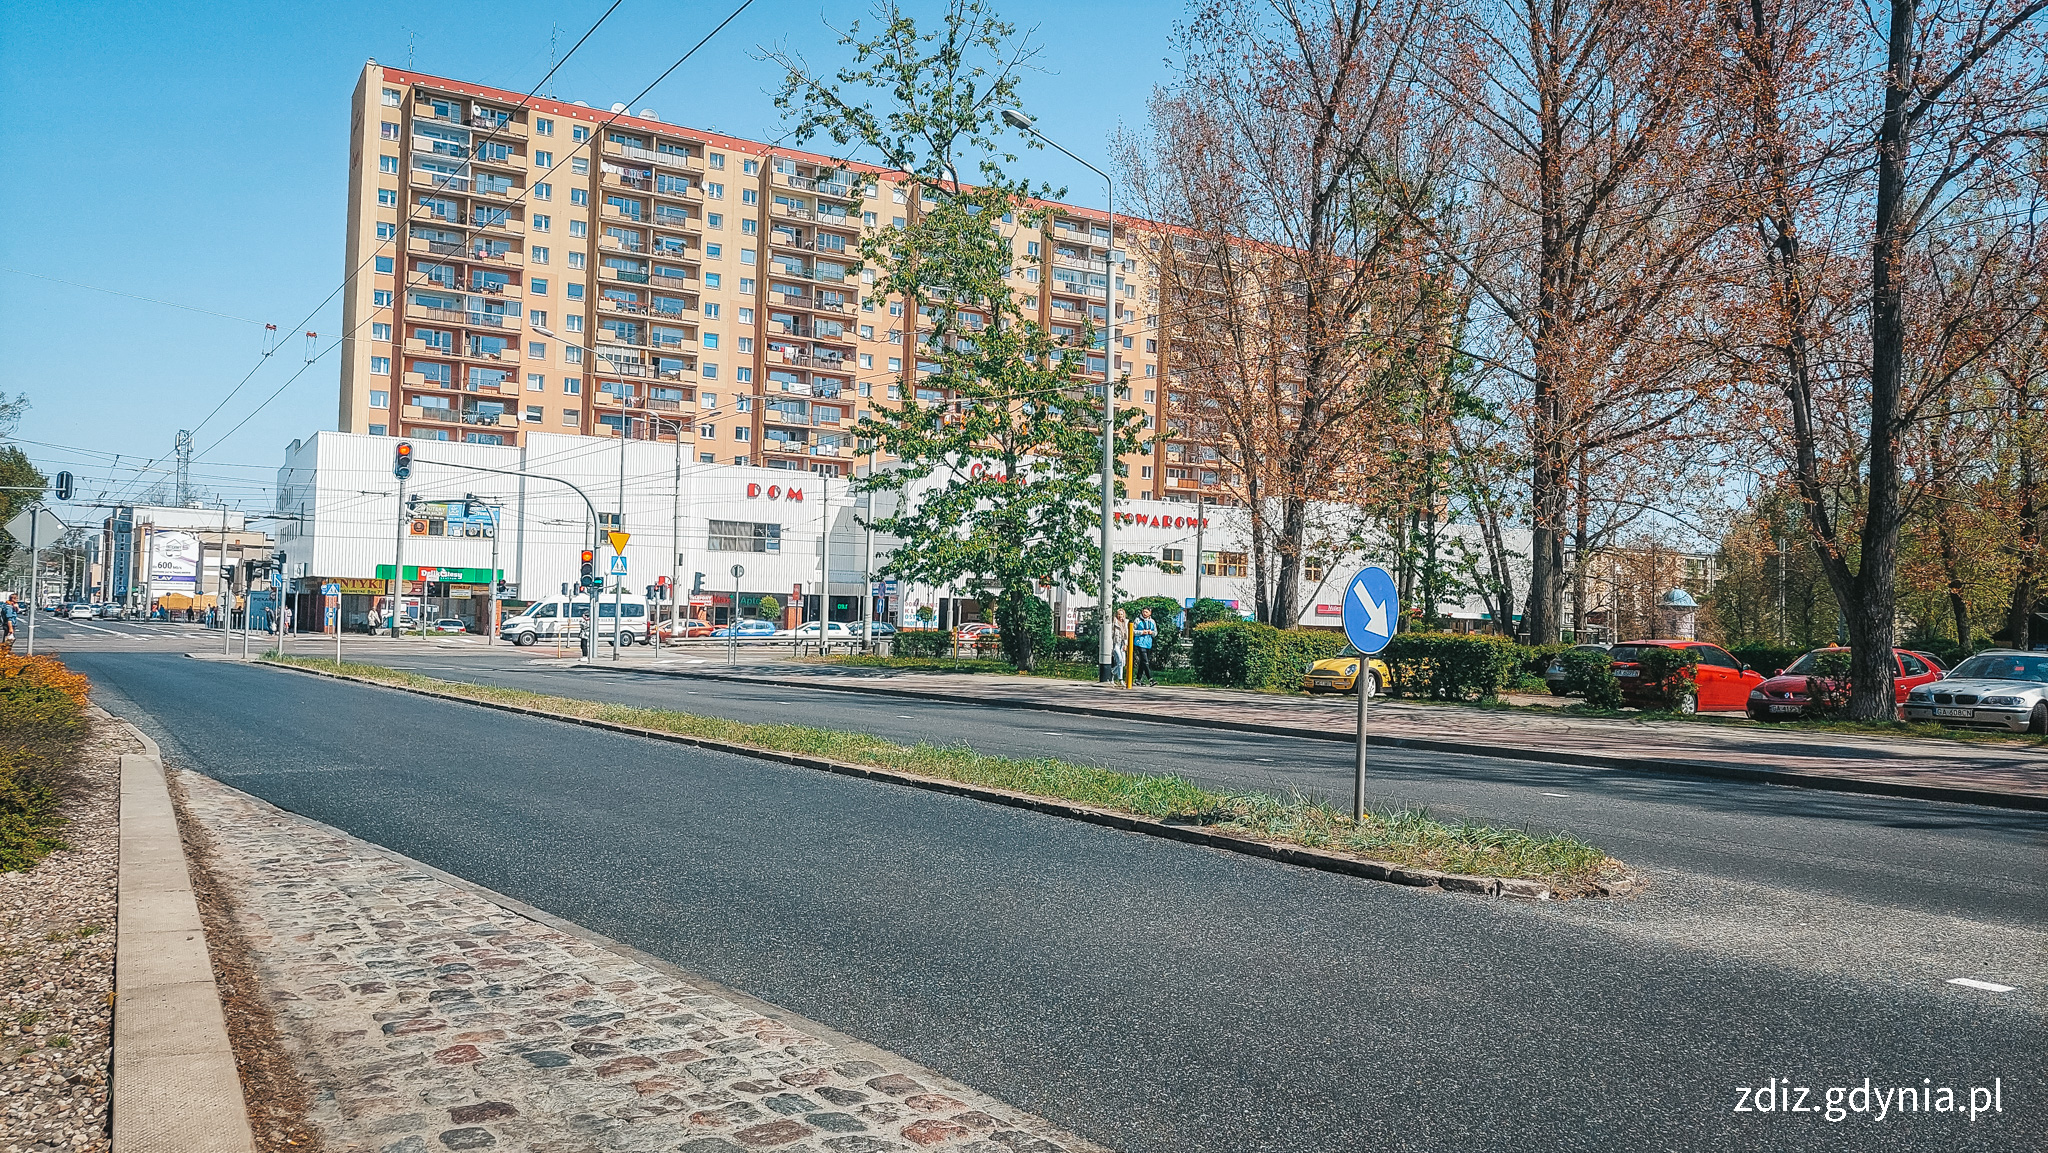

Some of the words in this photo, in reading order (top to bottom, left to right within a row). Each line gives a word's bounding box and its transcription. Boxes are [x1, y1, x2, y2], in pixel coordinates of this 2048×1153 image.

[746, 483, 804, 503] DOM
[1113, 512, 1210, 531] TOWAROWY
[157, 561, 173, 569] 600
